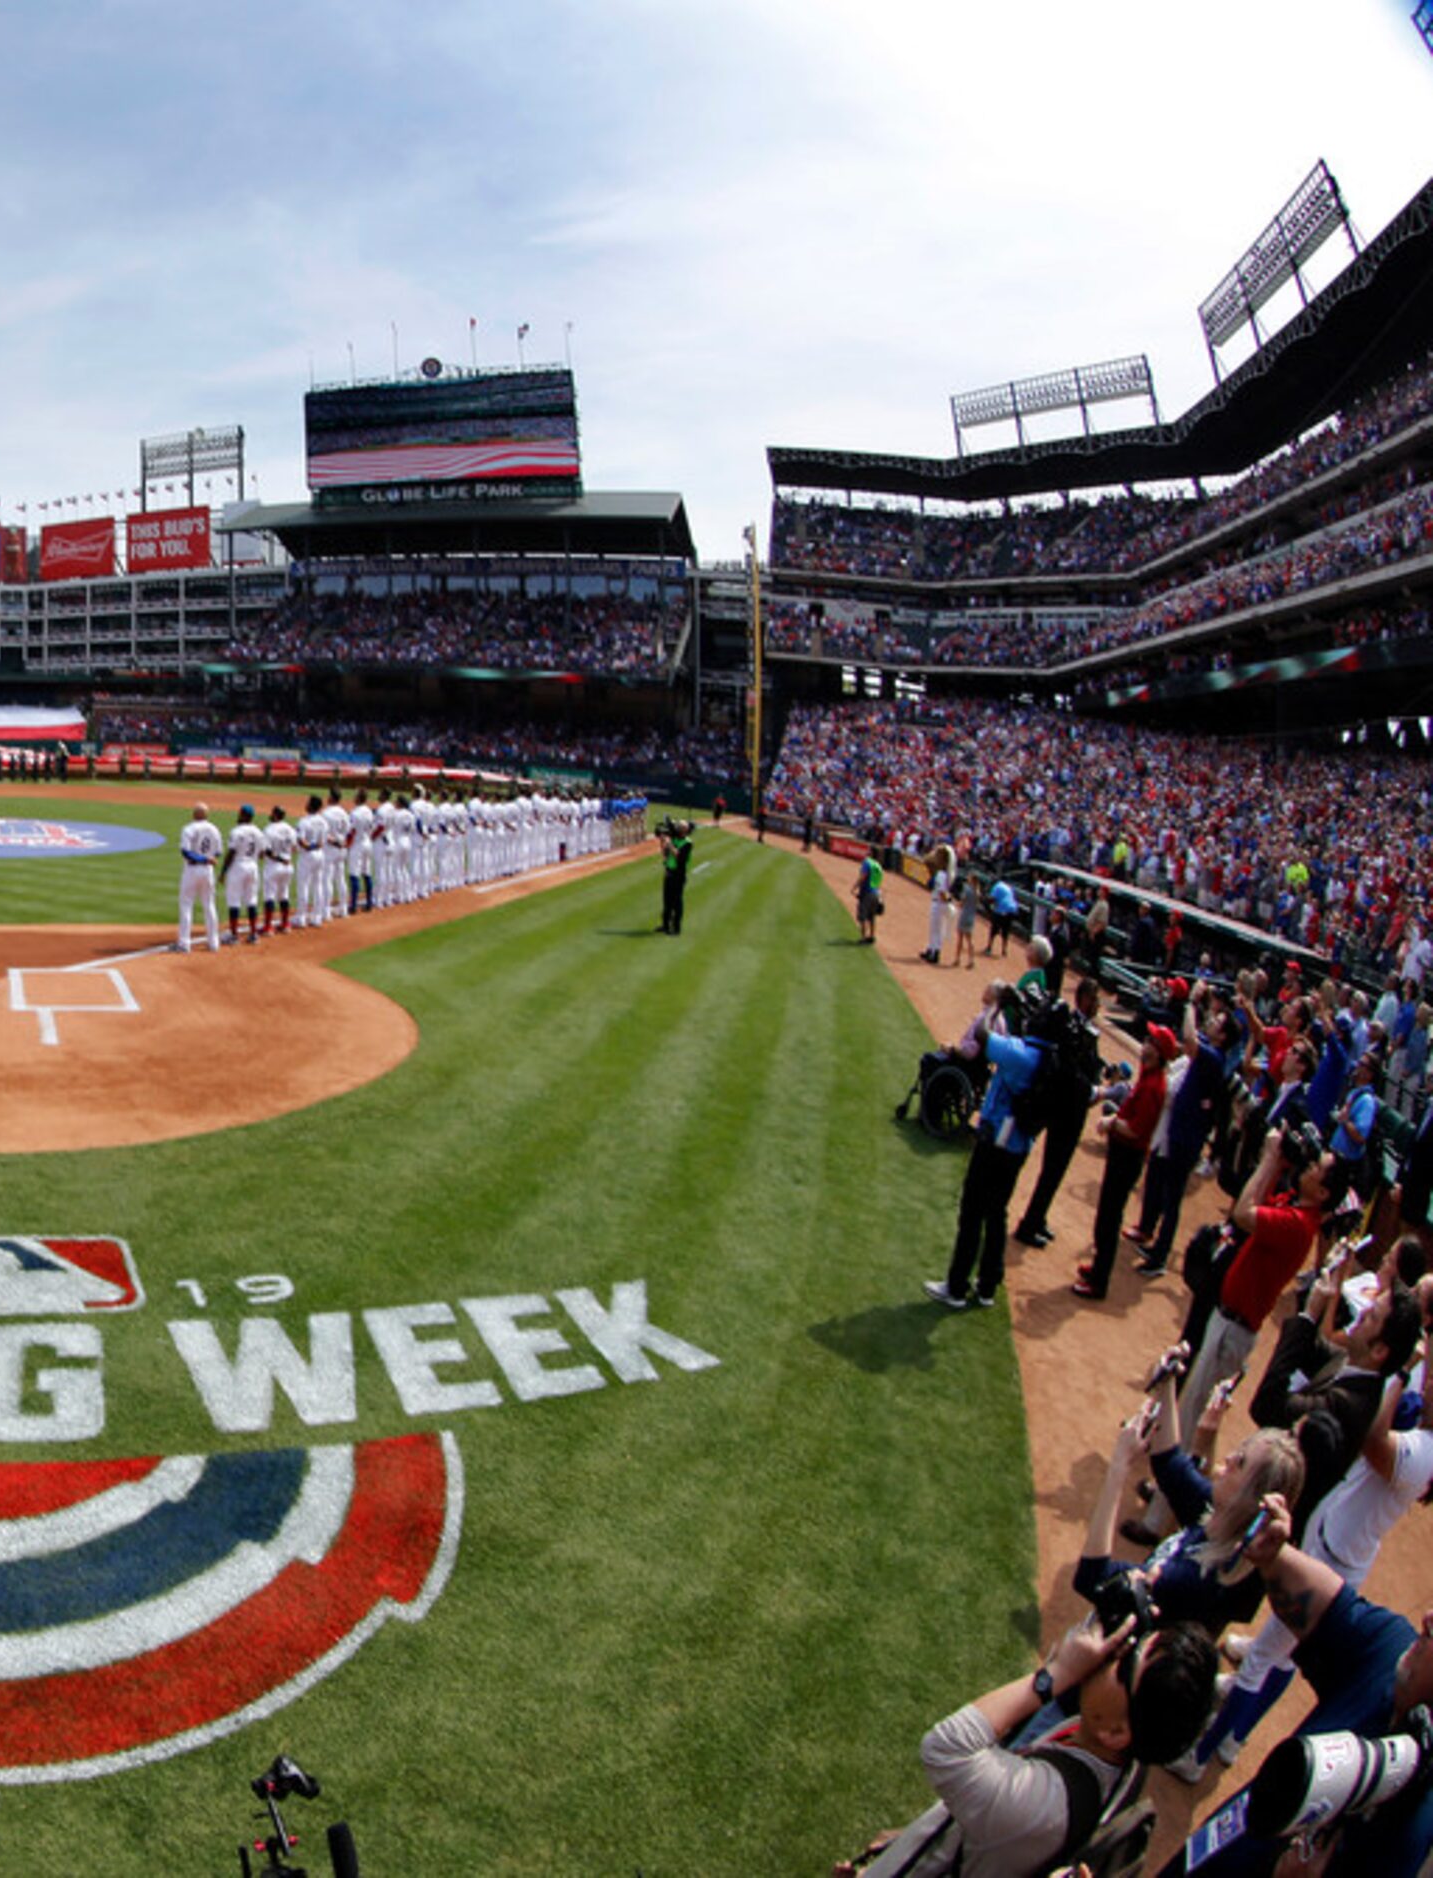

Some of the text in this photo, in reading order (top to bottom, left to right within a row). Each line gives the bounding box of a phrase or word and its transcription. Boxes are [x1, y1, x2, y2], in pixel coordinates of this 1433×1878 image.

[430, 485, 468, 499] LIFE
[474, 483, 524, 498] PARK
[130, 517, 206, 540] THIS BUD'S
[131, 542, 157, 560] FOR
[175, 1274, 295, 1308] 19
[166, 1278, 722, 1433] WEEK
